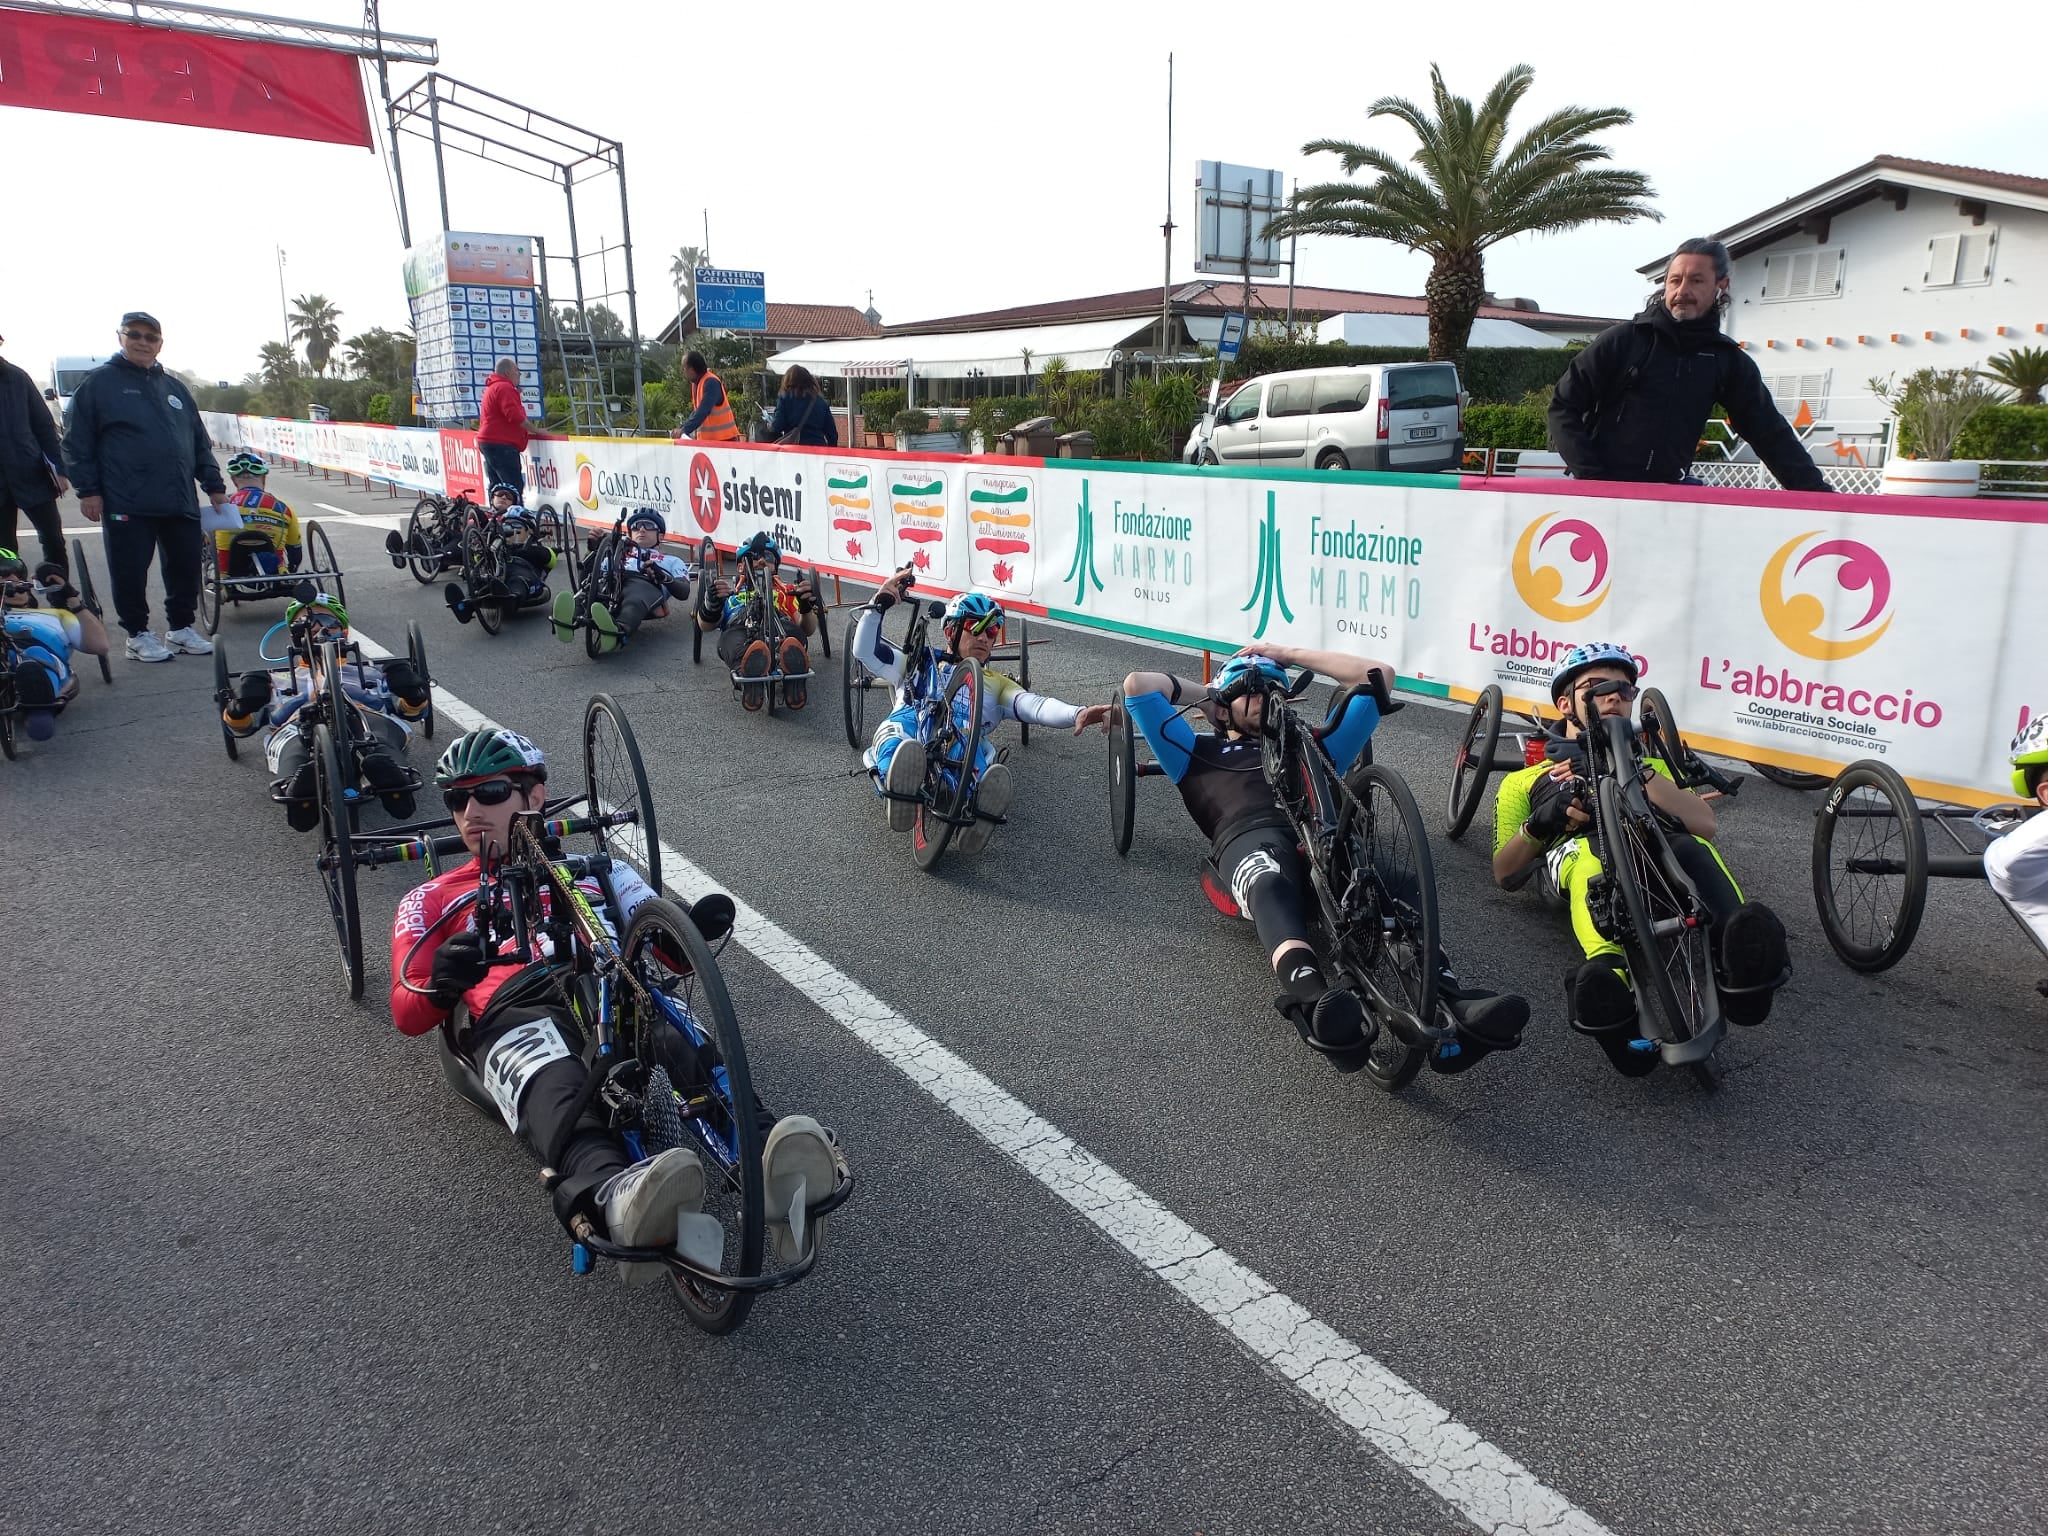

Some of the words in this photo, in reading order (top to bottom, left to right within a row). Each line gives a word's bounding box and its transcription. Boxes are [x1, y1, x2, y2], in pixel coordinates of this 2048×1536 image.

[696, 269, 763, 280] CAFFETTERIA
[702, 276, 757, 286] GELATERIA
[698, 298, 764, 313] PANCINO
[723, 466, 802, 522] sistemi
[1114, 500, 1192, 541] Fondazione
[1310, 515, 1422, 566] Fondazione
[1112, 543, 1192, 587] MARMO
[1133, 586, 1171, 604] ONLUS
[1309, 566, 1421, 620] MARMO
[1336, 618, 1388, 640] ONLUS
[1506, 660, 1554, 677] Cooperati
[1699, 656, 1943, 728] L'abbraccio
[1736, 715, 1887, 754] www.labbracciocoopsoc.org
[1748, 702, 1824, 726] Cooperativa
[1827, 716, 1877, 736] Sociale
[489, 1027, 551, 1101] 204
